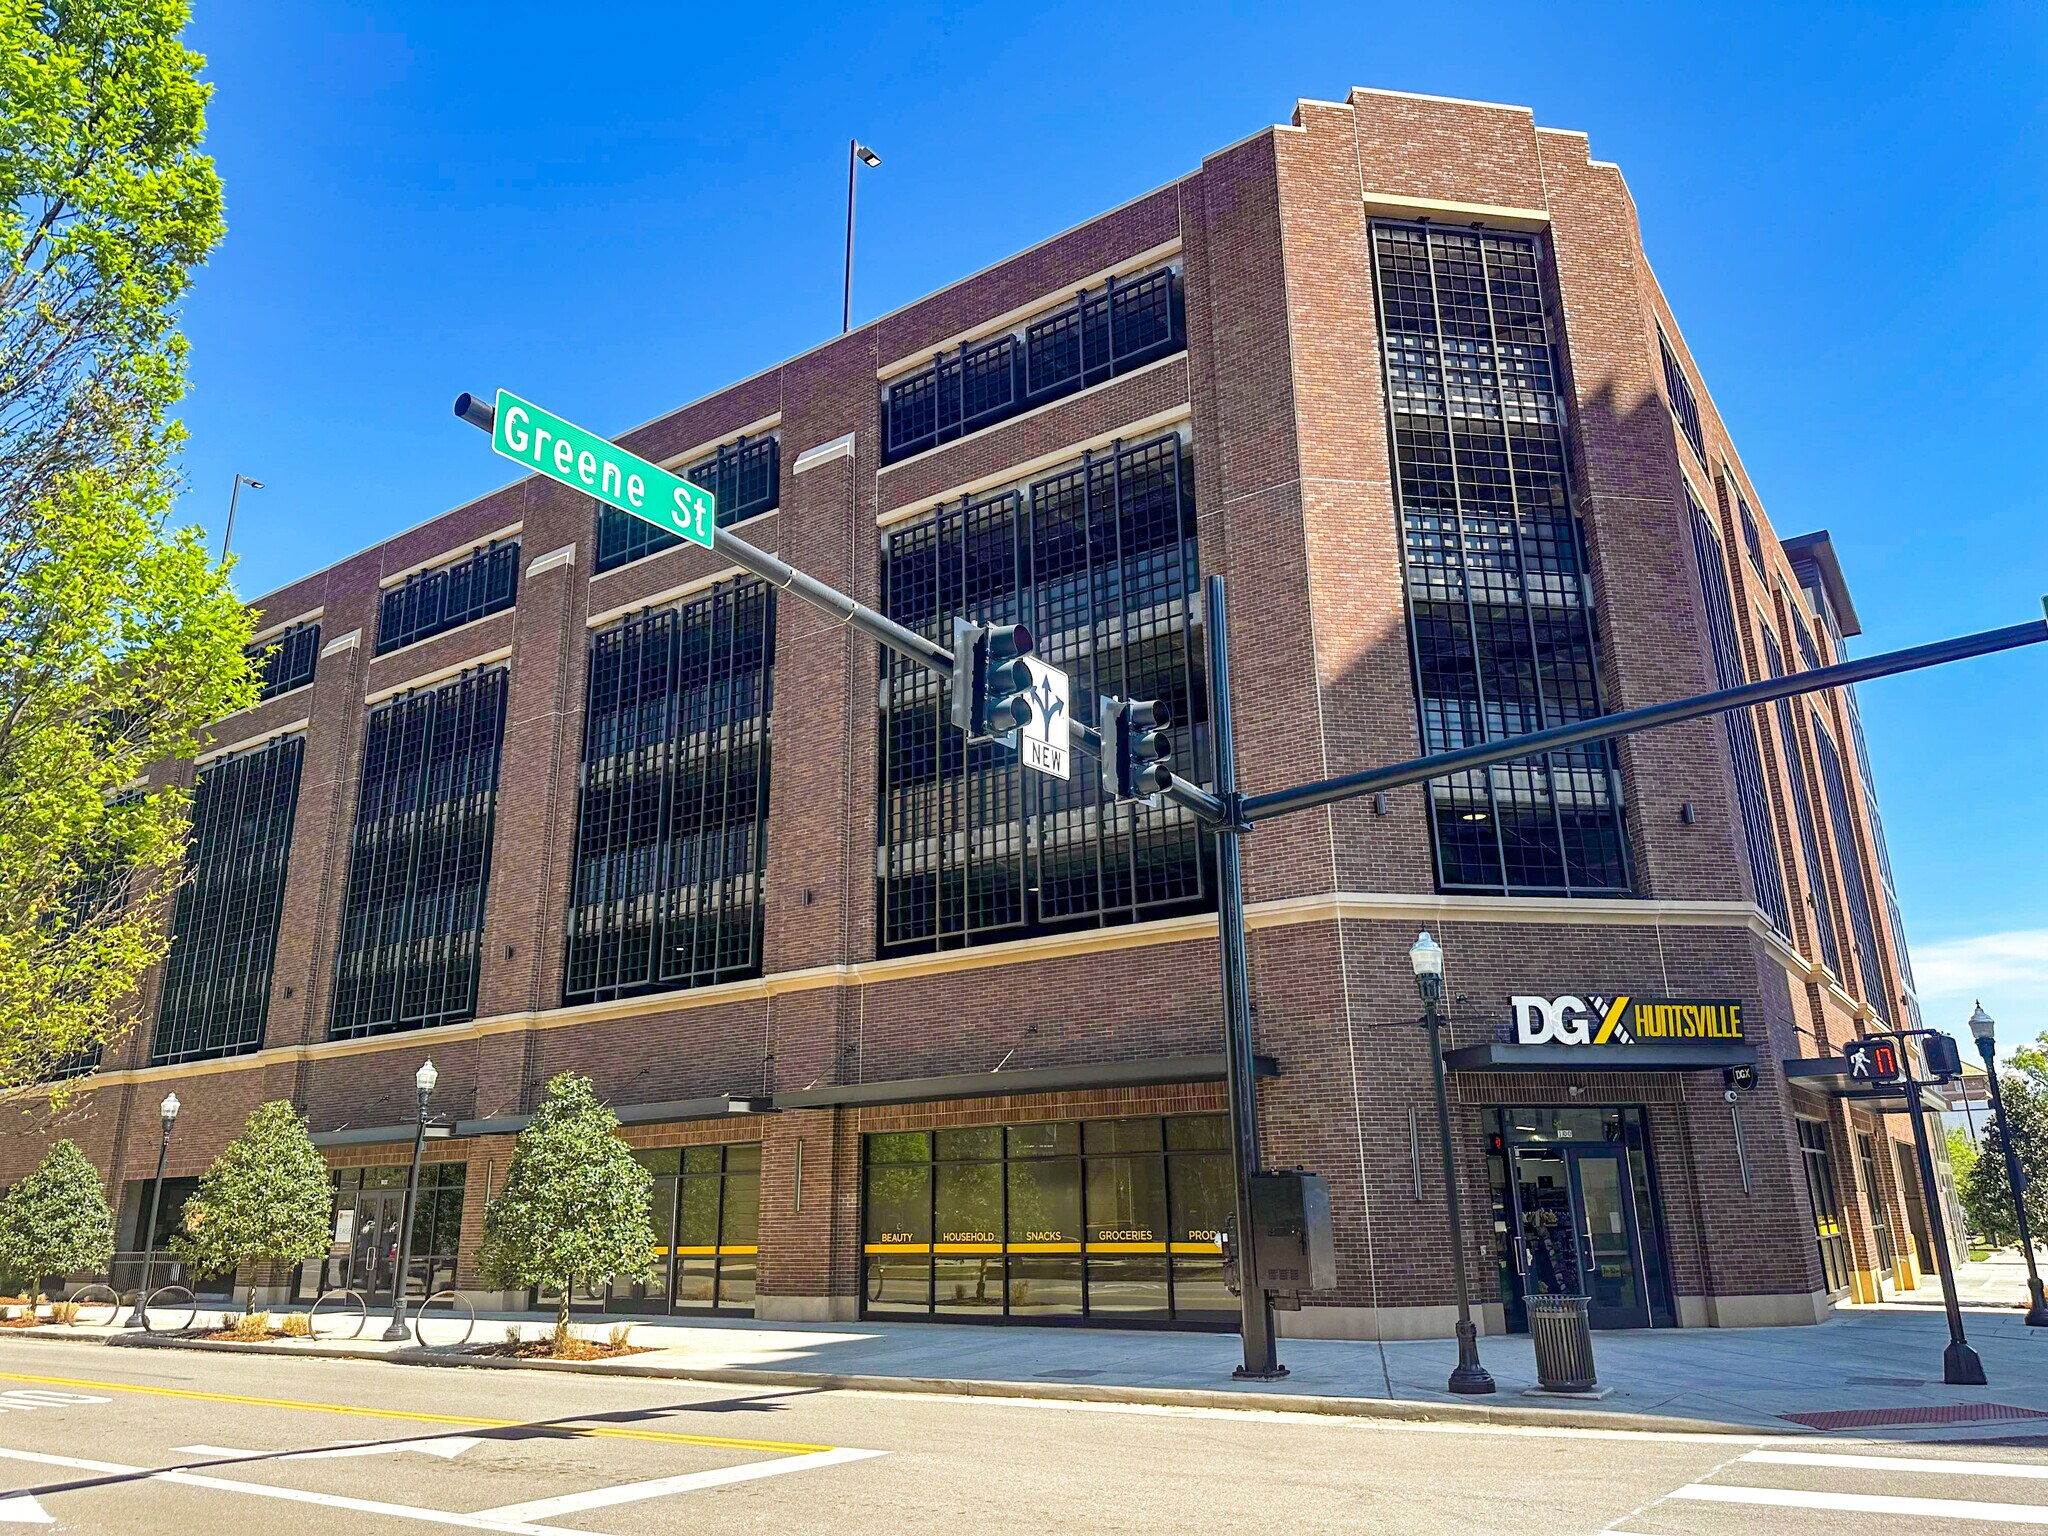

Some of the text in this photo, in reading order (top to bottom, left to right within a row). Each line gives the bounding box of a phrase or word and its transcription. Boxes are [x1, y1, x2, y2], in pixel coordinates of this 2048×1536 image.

[504, 406, 706, 537] Greene St
[1032, 742, 1061, 772] NEW
[1511, 995, 1743, 1045] DGX HUNTSVILLE
[1875, 1047, 1895, 1073] 17
[1735, 1068, 1751, 1080] DGX
[881, 1232, 914, 1242] BEAUTY
[943, 1232, 995, 1242] HOUSEHOLD
[1026, 1231, 1061, 1241] SNACKS
[1098, 1230, 1153, 1241] GROCERIES
[1188, 1230, 1220, 1241] PROD
